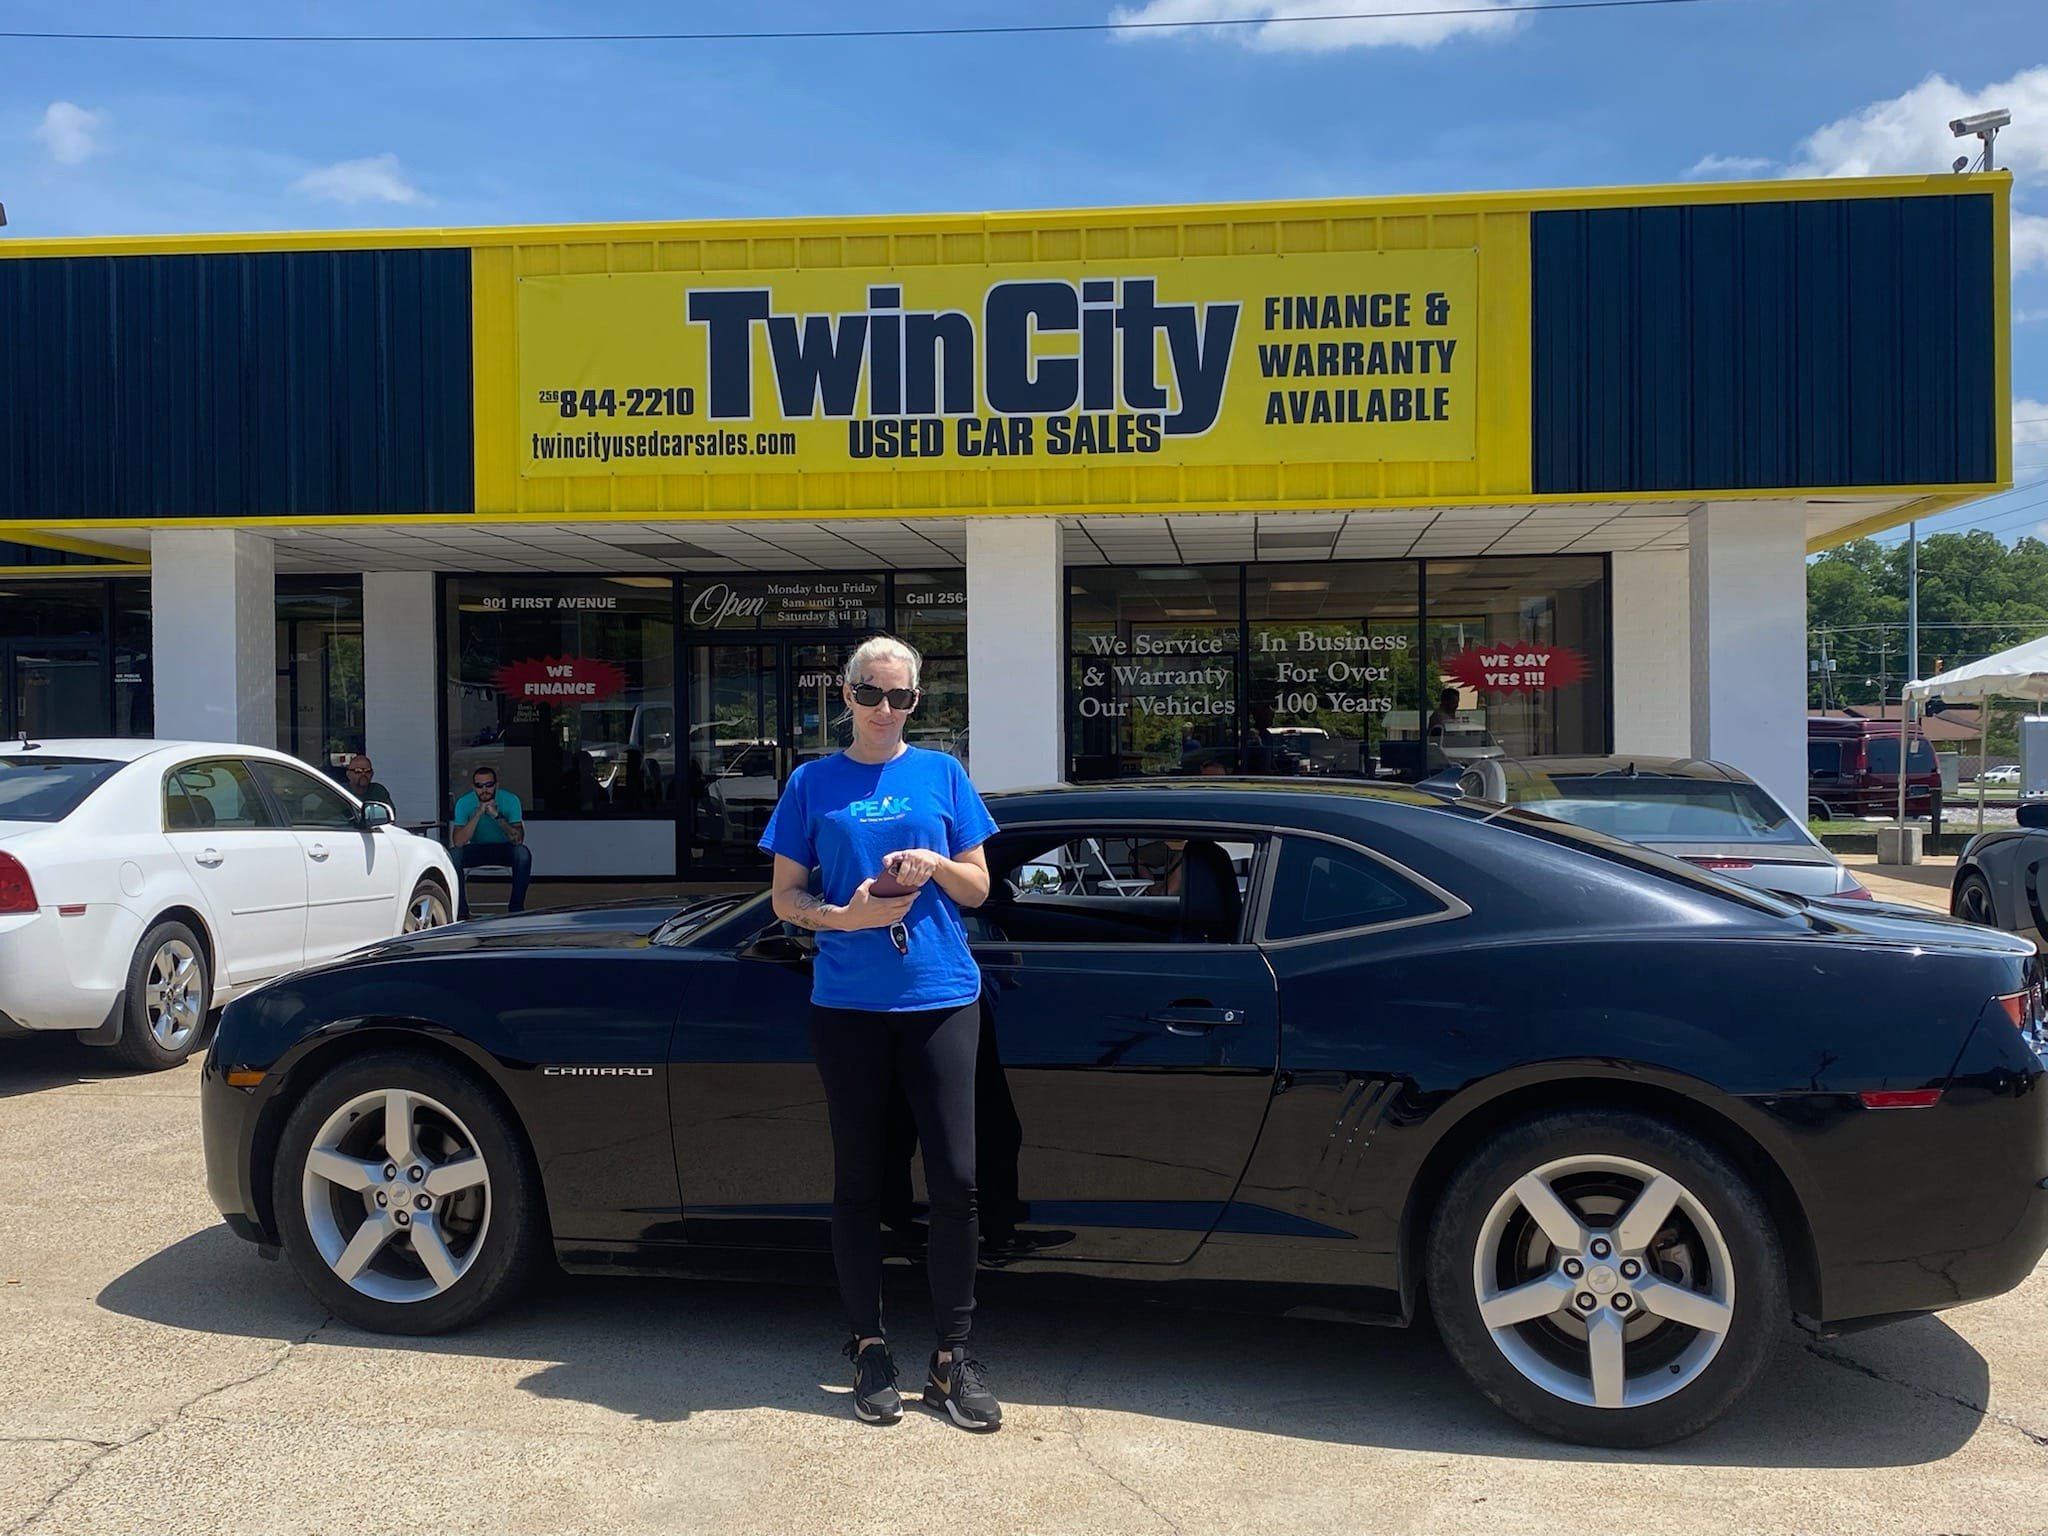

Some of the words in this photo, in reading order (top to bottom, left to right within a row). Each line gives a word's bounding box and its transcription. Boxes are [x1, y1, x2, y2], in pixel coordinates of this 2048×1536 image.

[1264, 293, 1410, 331] FINANCE
[1425, 292, 1451, 327] &
[1258, 339, 1457, 378] WARRANTY
[538, 390, 559, 402] 256
[559, 387, 695, 418] 844-2210
[1264, 387, 1450, 425] AVAILABLE
[531, 429, 797, 463] twincityusedcarsales.com
[849, 418, 944, 459] USED
[956, 417, 1033, 456] CAR
[1046, 413, 1161, 454] SALES
[767, 584, 812, 596] Monday
[814, 583, 839, 594] thru
[842, 582, 878, 594] Friday
[906, 592, 934, 605] Call
[483, 597, 507, 610] 901
[511, 597, 553, 609] FIRST
[557, 597, 617, 609] AVENUE
[689, 583, 769, 628] Open
[782, 598, 805, 608] 8am
[808, 597, 835, 608] until
[838, 598, 863, 610] 5pm
[777, 611, 826, 624] Saturday
[828, 611, 836, 622] 8
[838, 609, 851, 621] til
[854, 609, 868, 621] 12
[1089, 635, 1127, 656] We
[1135, 633, 1224, 655] Service
[1259, 632, 1289, 652] In
[1297, 631, 1408, 651] Business
[1479, 655, 1509, 667] WE
[1513, 654, 1551, 667] SAY
[546, 665, 574, 678] WE
[799, 675, 833, 688] AUTO
[1083, 667, 1105, 687] &
[1113, 666, 1231, 690] Warranty
[1276, 662, 1319, 683] For
[1327, 660, 1390, 682] Over
[1485, 672, 1520, 686] YES
[1524, 672, 1545, 686] !!!
[524, 683, 596, 695] FINANCE
[1078, 697, 1129, 718] Our
[1135, 694, 1236, 716] Vehicles
[1273, 692, 1318, 714] 100
[1325, 691, 1392, 712] Years
[850, 796, 912, 817] PEAK
[543, 1066, 653, 1076] CAMARO
